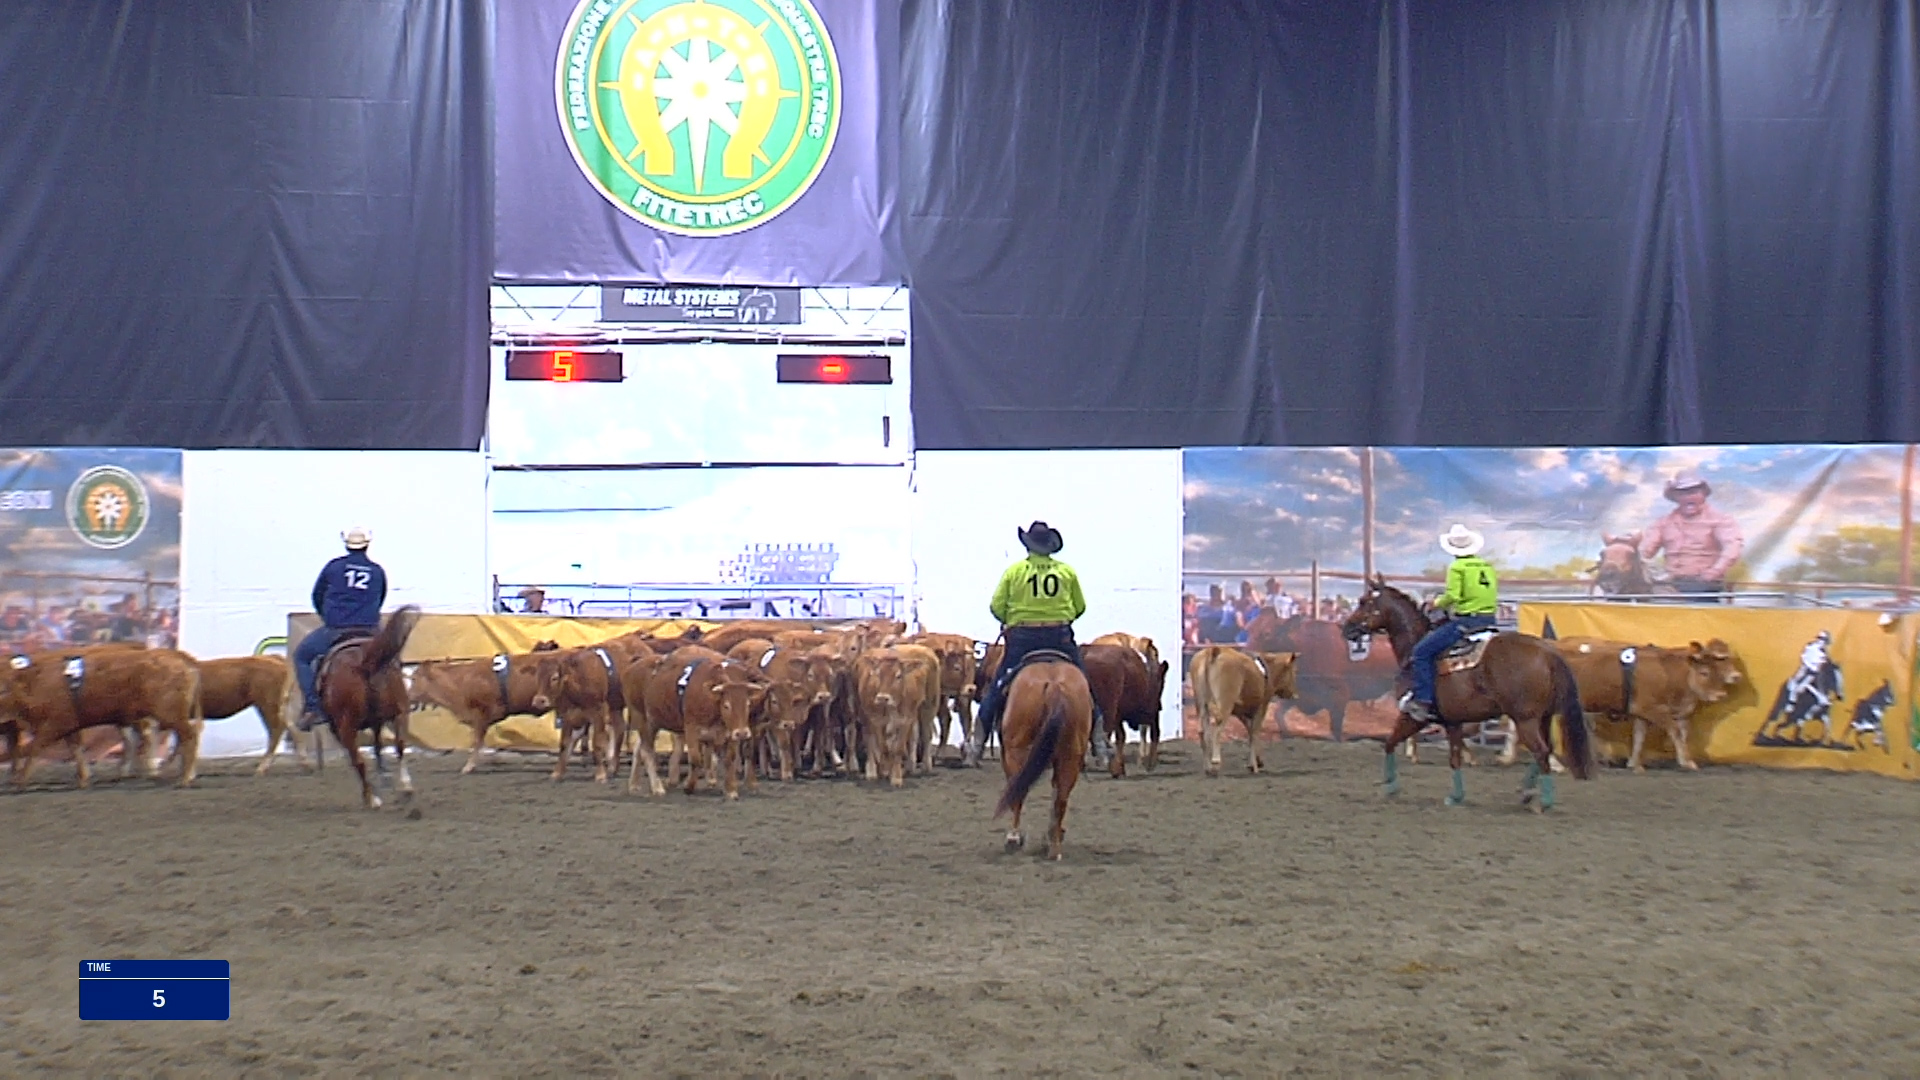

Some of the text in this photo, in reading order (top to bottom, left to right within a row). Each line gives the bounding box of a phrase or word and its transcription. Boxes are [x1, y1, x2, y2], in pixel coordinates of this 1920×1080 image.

[631, 185, 764, 226] FITETREC
[623, 288, 740, 307] METAL SYSTEMS
[553, 351, 573, 382] 5
[344, 569, 371, 590] 12
[1027, 573, 1059, 598] 10
[1479, 570, 1490, 589] 4
[973, 642, 987, 660] 5
[1620, 647, 1636, 664] 6
[677, 665, 692, 685] 2
